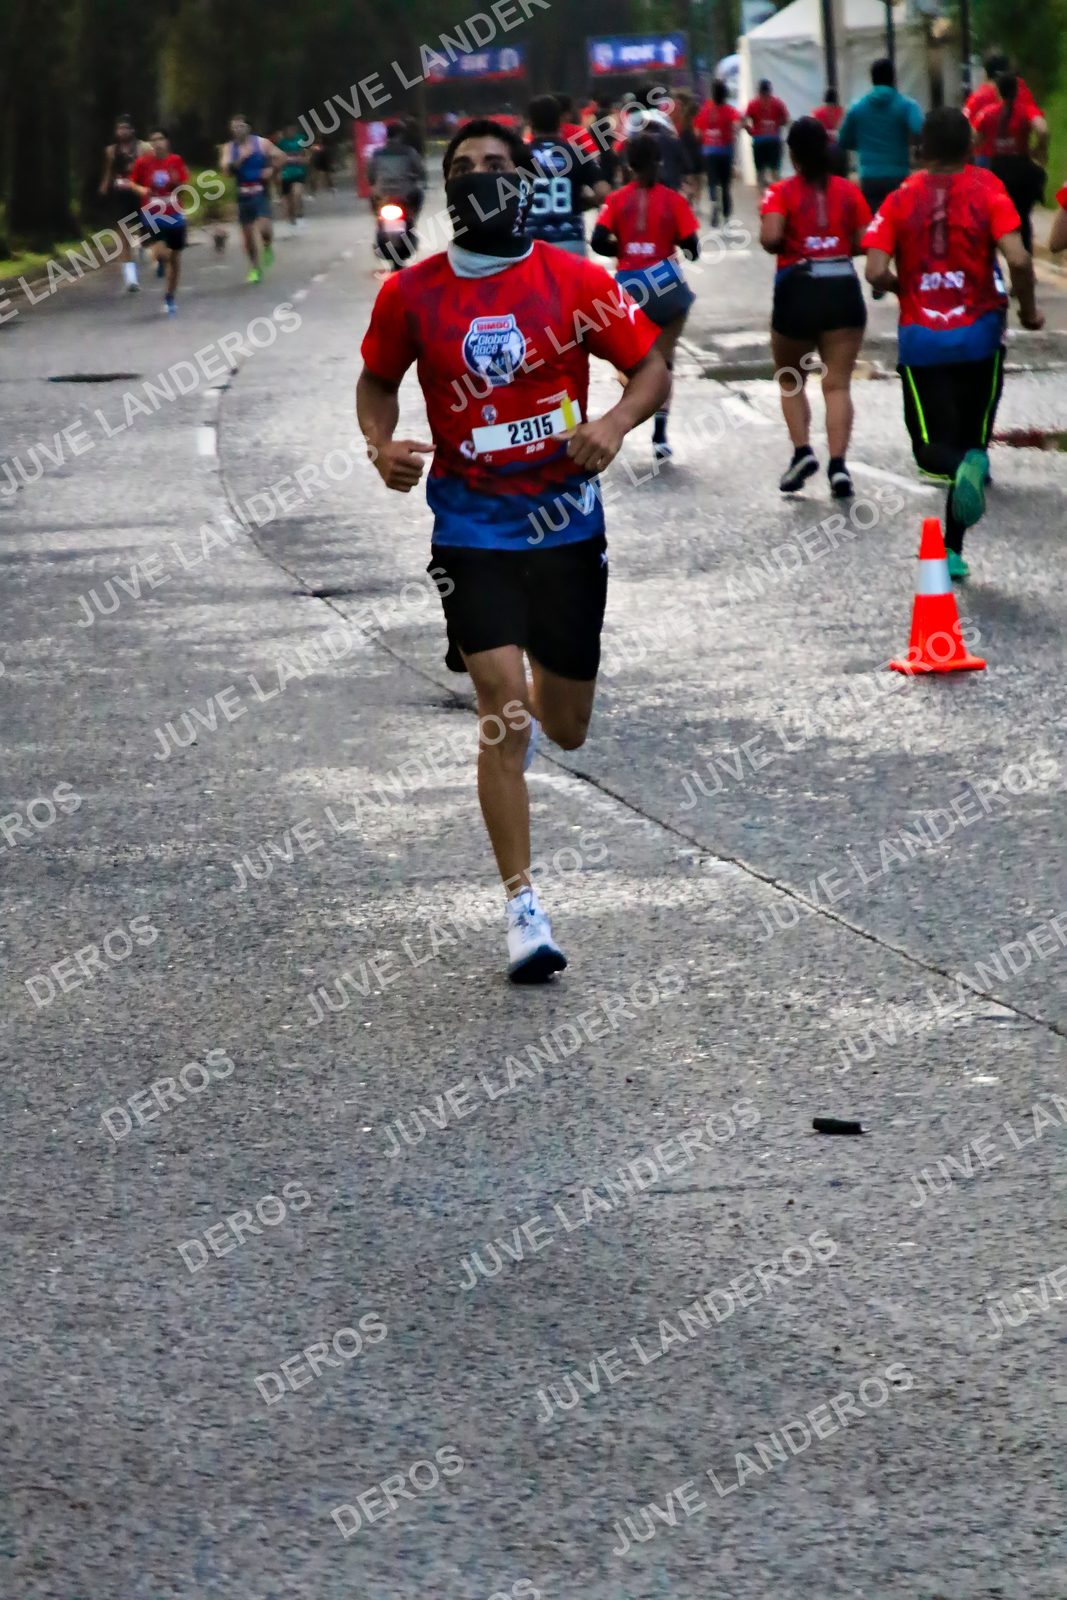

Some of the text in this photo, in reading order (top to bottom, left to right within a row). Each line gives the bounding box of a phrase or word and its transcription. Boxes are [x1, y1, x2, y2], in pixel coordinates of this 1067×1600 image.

[478, 333, 510, 346] Global
[473, 345, 498, 356] Race
[508, 414, 553, 445] 2315
